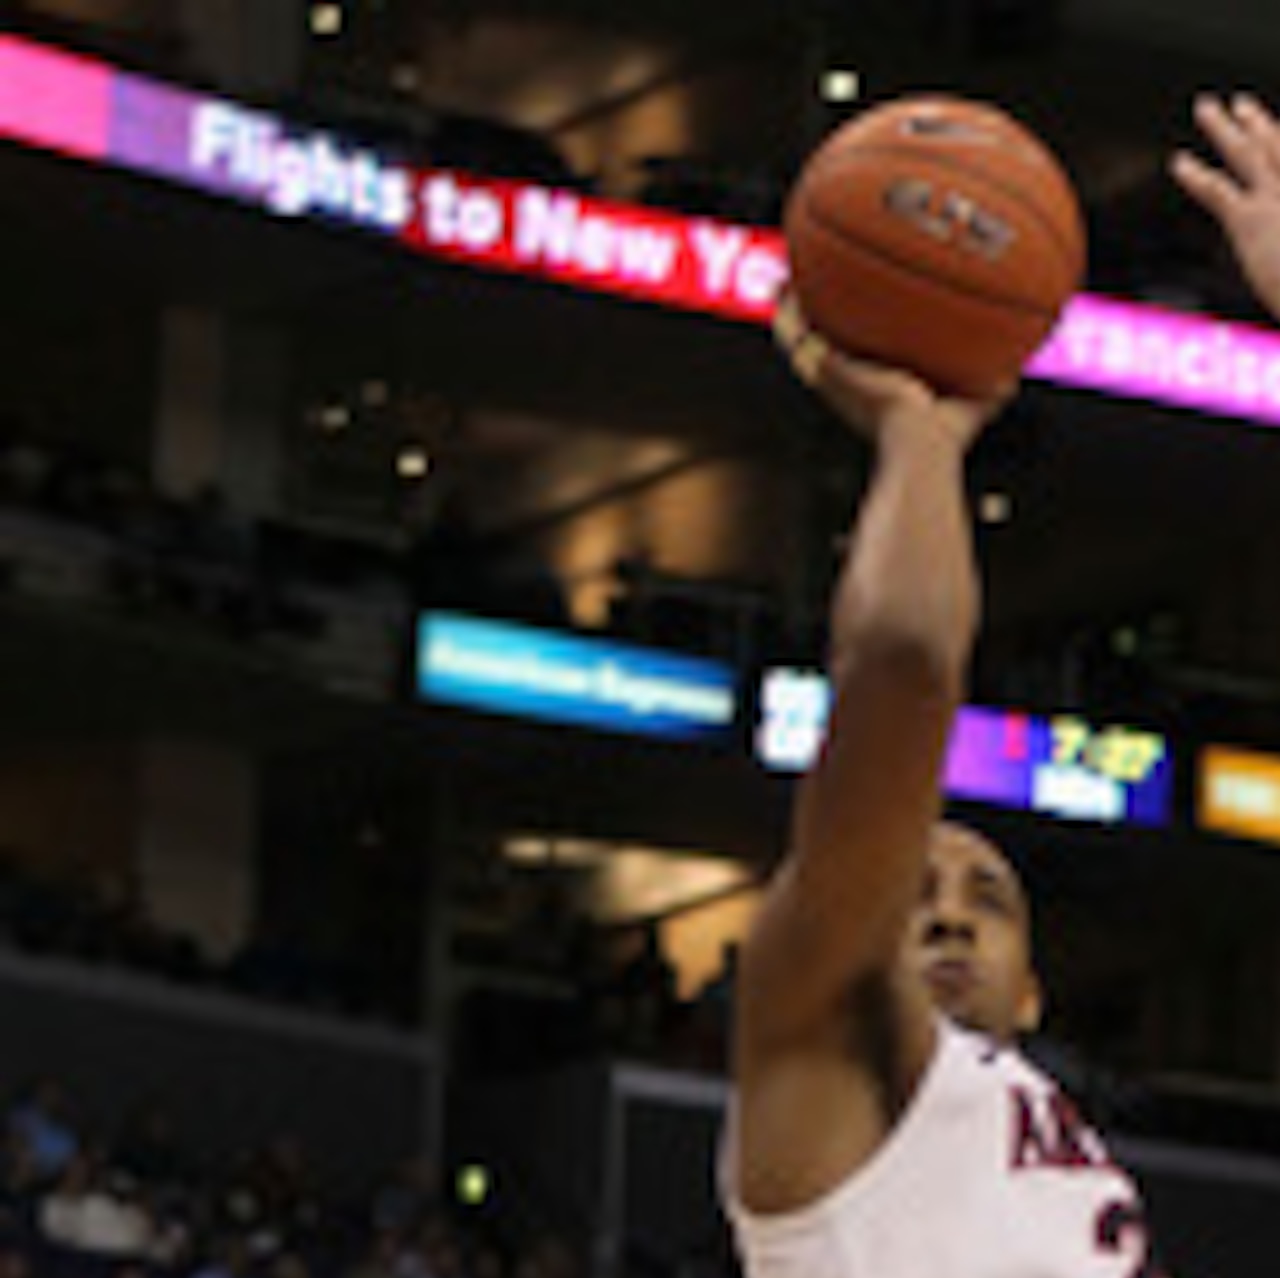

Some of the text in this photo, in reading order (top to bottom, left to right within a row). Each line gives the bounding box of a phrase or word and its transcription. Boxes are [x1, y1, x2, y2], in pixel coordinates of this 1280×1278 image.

[190, 100, 408, 220] Flights
[420, 172, 500, 248] to
[513, 182, 676, 284] New
[688, 212, 790, 304] Yo
